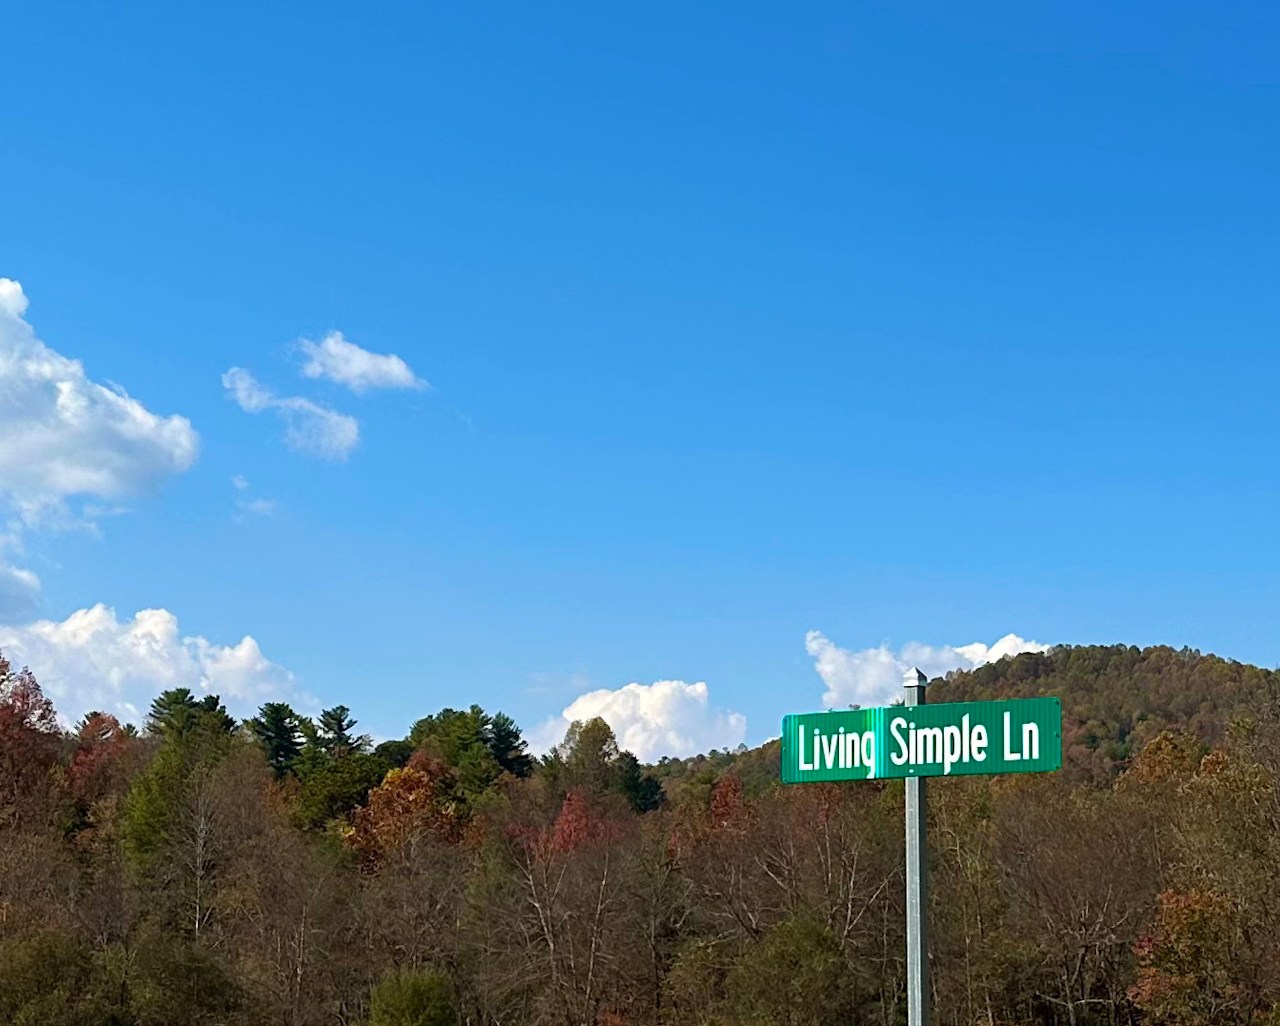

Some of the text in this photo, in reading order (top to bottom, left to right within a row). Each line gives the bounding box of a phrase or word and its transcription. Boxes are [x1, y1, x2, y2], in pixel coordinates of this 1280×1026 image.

[799, 711, 1040, 779] Living Simple Ln
